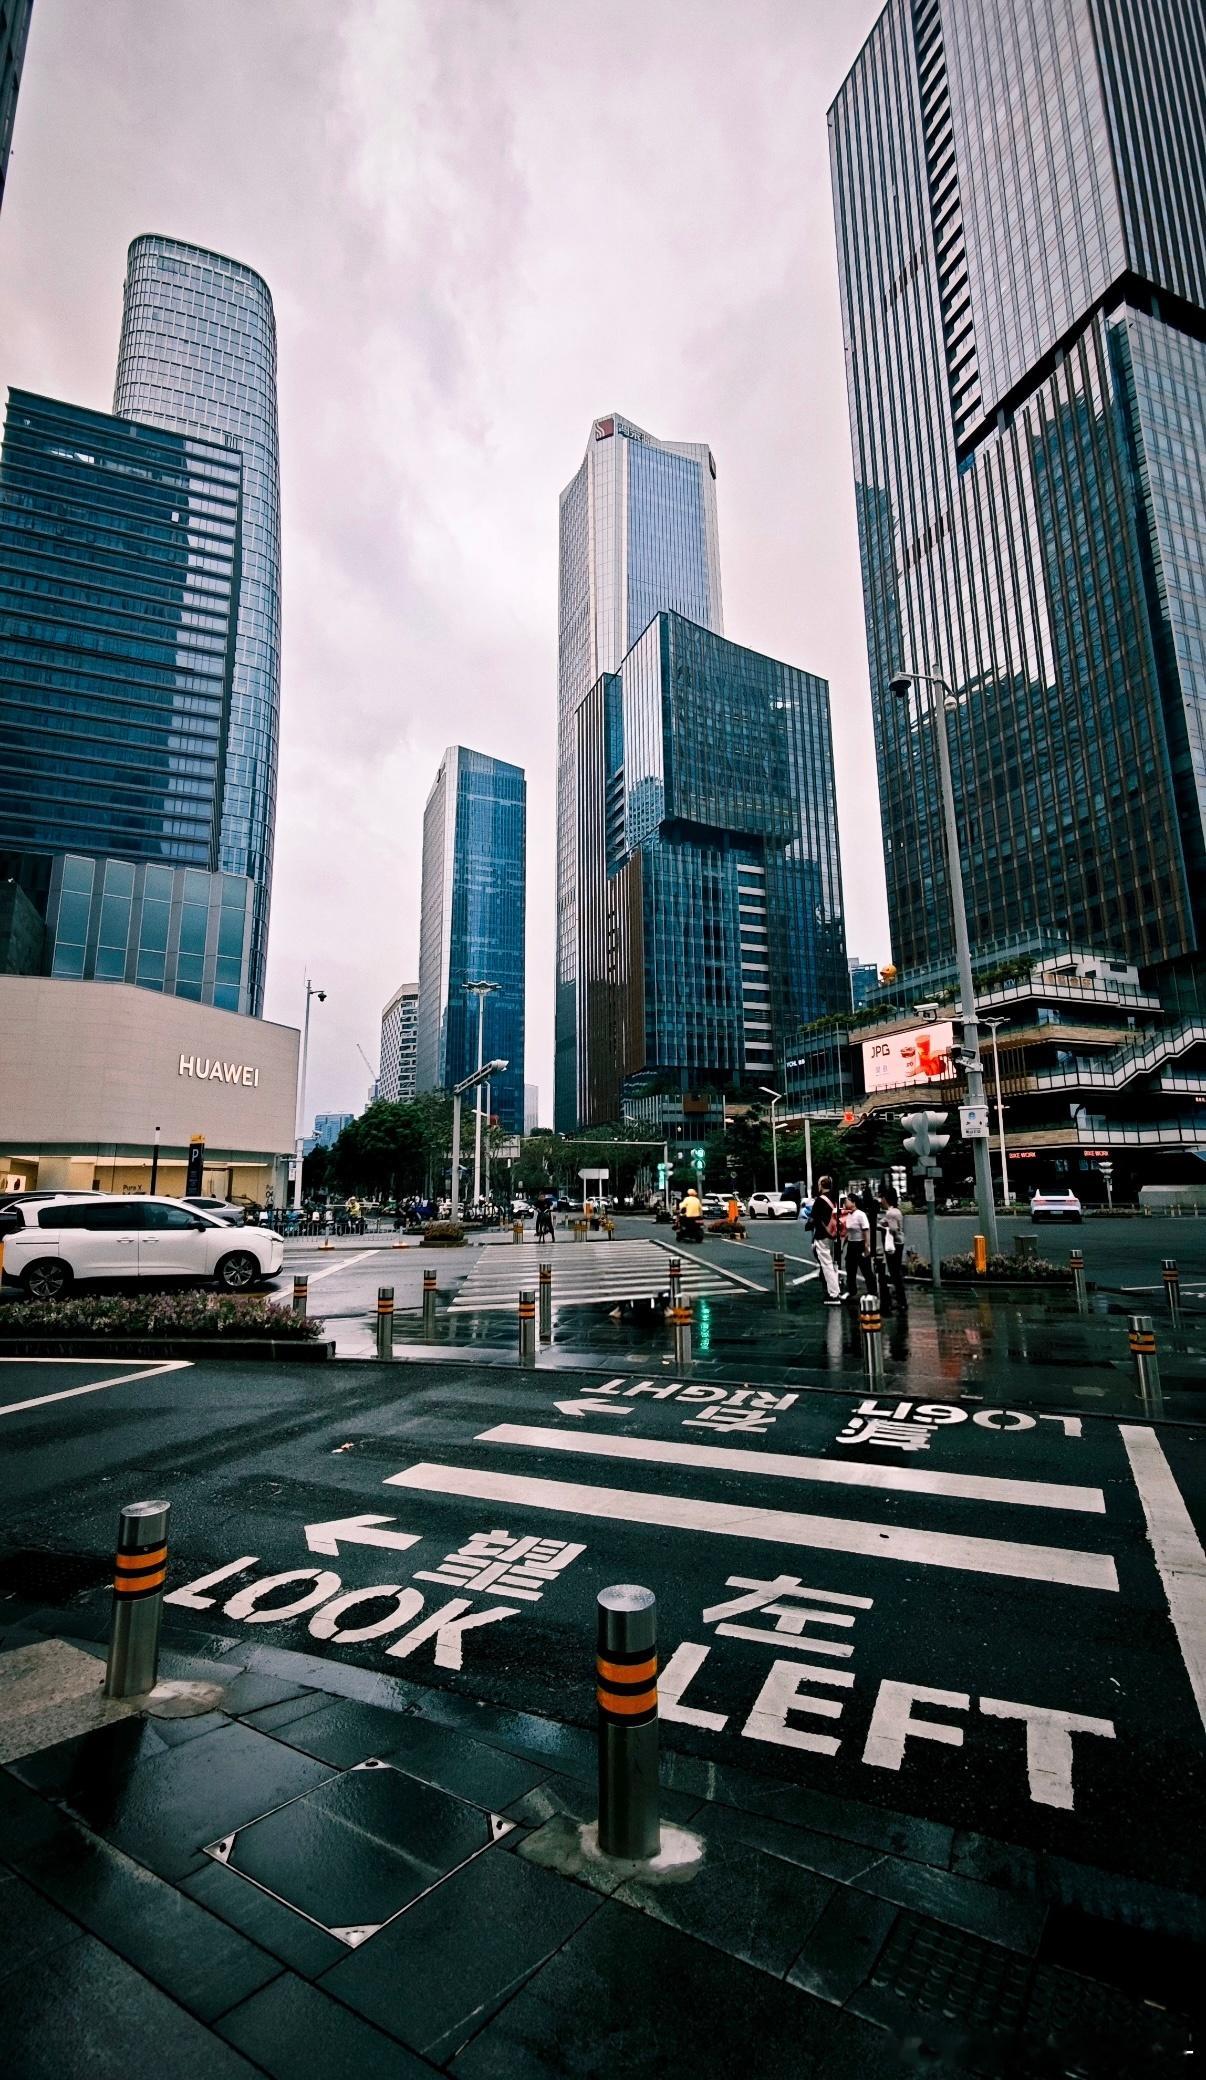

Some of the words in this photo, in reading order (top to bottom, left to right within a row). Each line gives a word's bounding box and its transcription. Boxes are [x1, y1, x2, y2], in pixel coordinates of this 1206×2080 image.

[871, 1043, 891, 1059] JPG
[179, 1054, 260, 1088] HUAWEI
[191, 1148, 199, 1162] P
[580, 1378, 800, 1411] RIGHT
[682, 1406, 777, 1434] 右
[413, 1530, 588, 1601] 望
[163, 1556, 522, 1671] LOOK
[703, 1575, 875, 1658] 左
[656, 1642, 1117, 1811] LEFT
